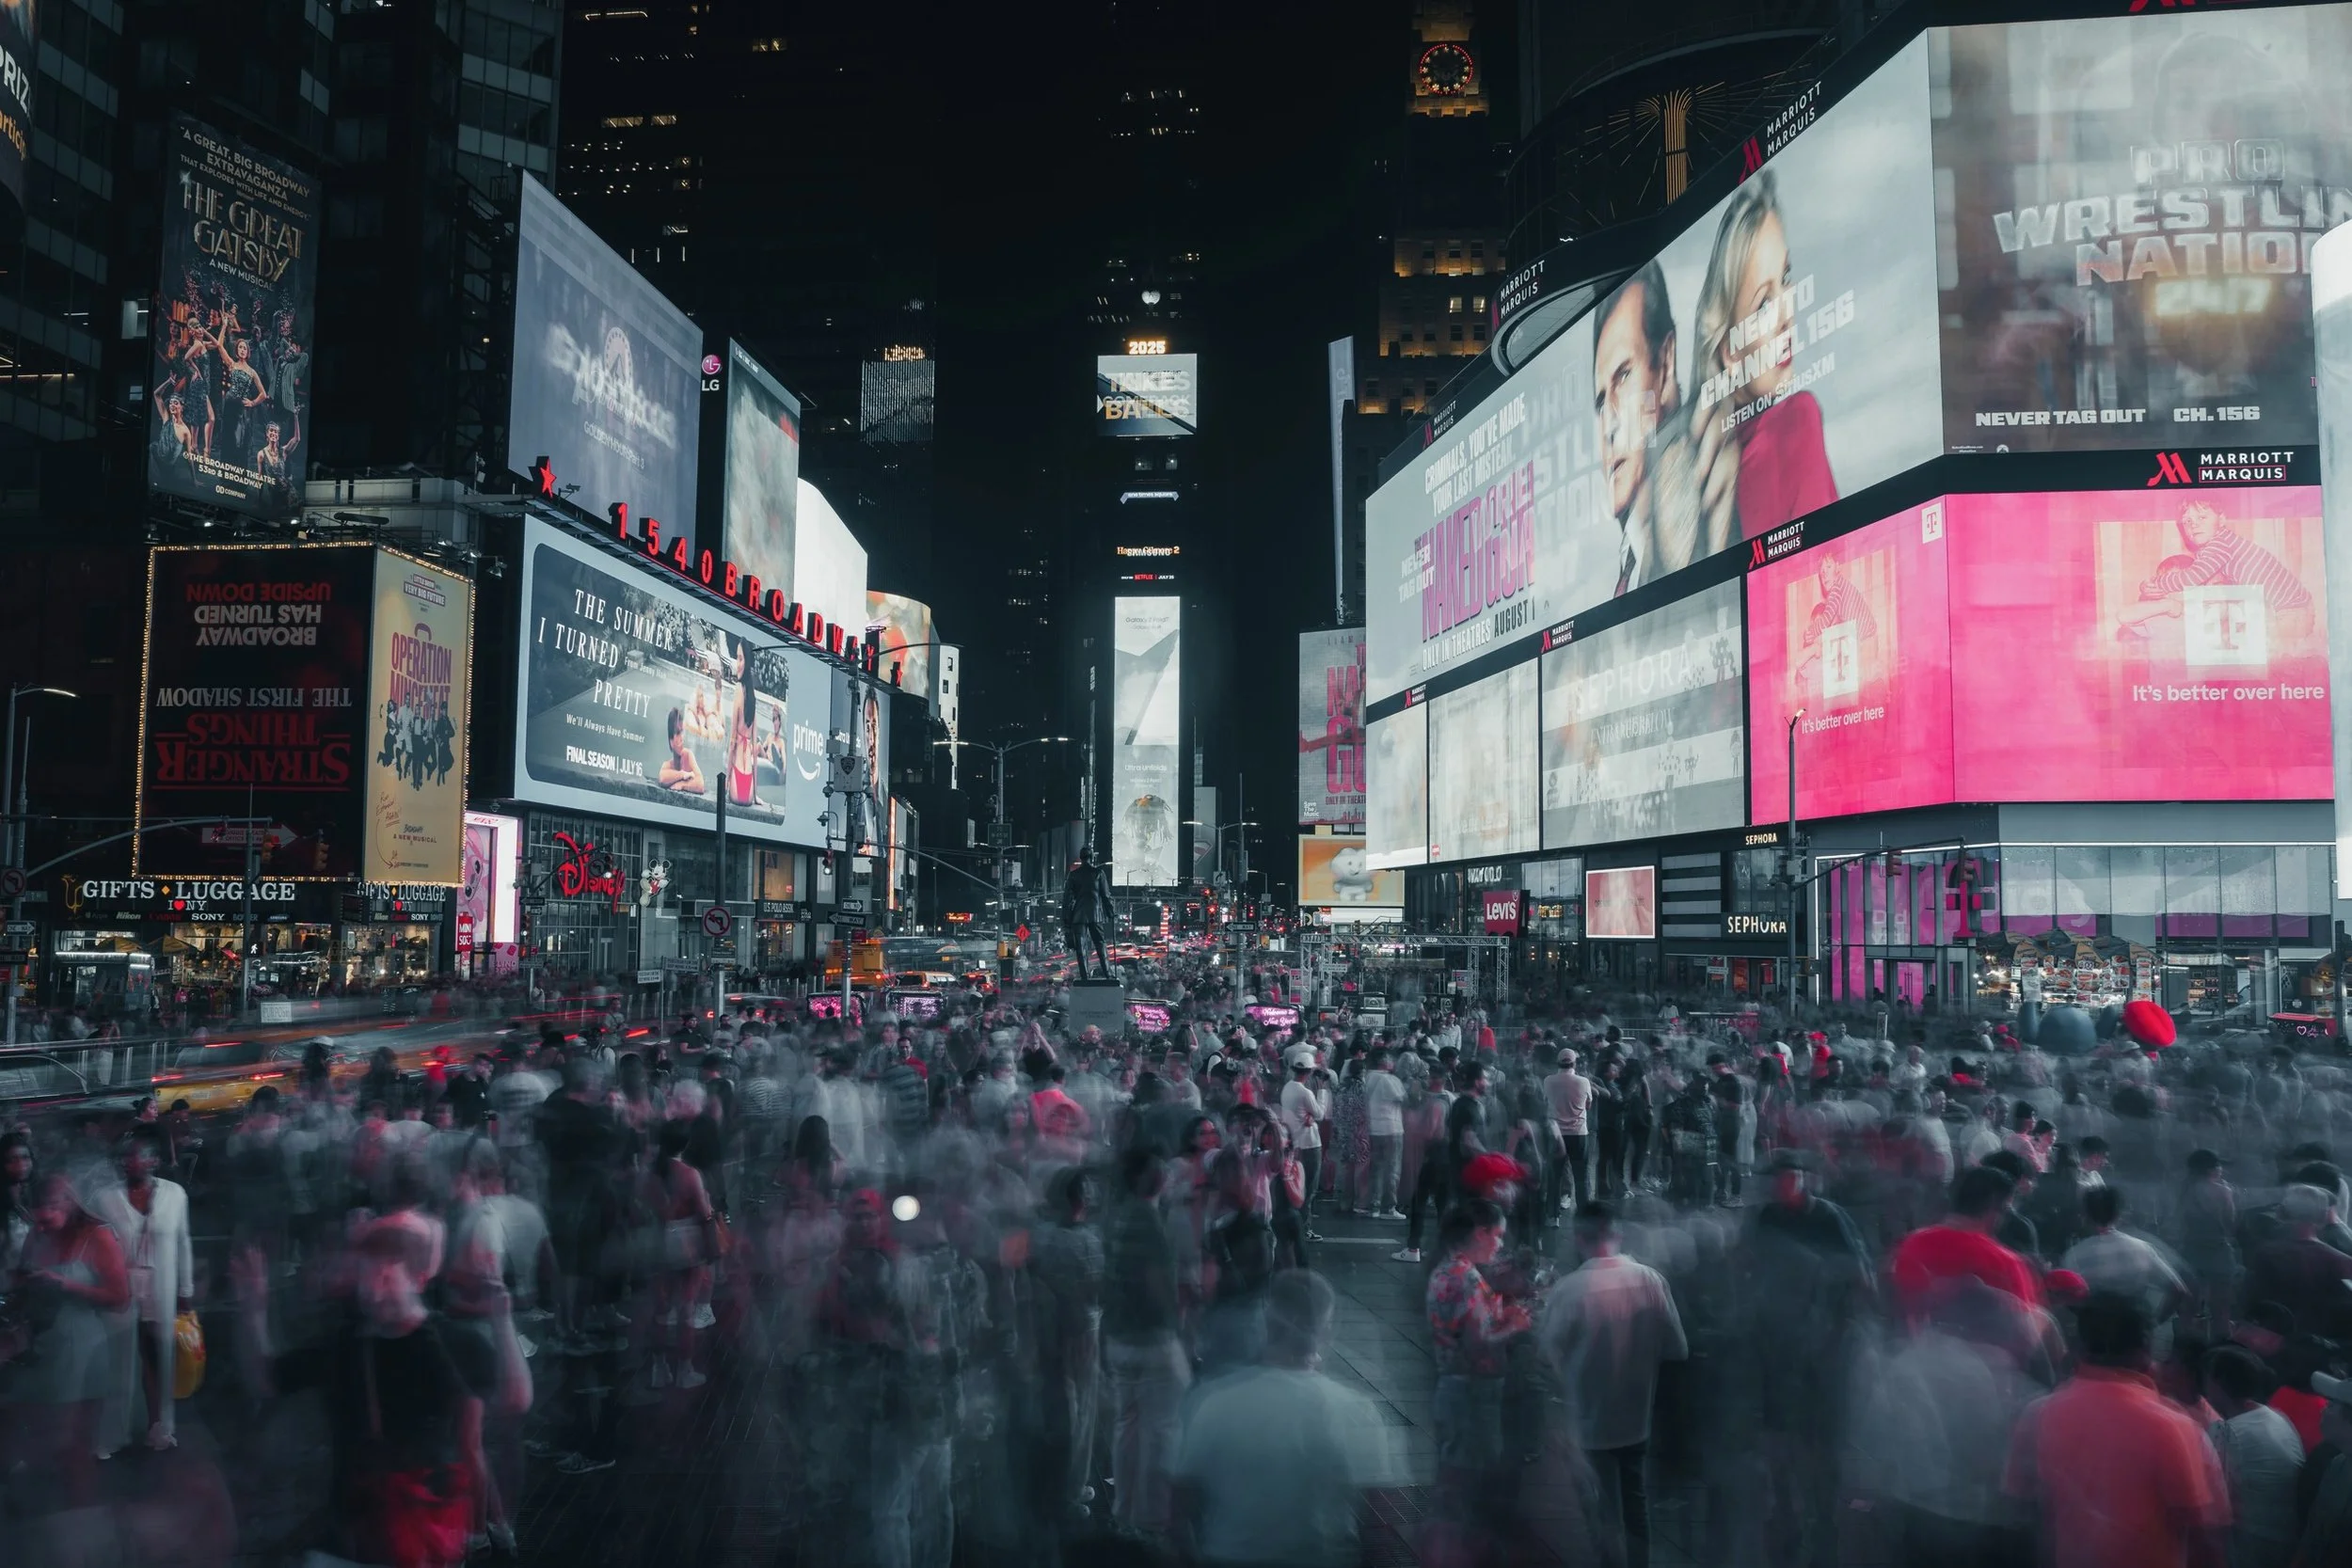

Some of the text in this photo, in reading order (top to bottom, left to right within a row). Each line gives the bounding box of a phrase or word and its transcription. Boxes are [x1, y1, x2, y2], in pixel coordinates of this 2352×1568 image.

[1767, 81, 1821, 137] MARRIOTT
[1767, 106, 1816, 157] MARQUIS
[194, 133, 231, 160] GREAT,
[234, 152, 252, 169] BIG
[255, 163, 310, 198] BROADWAY
[206, 152, 288, 201] EXTRAVAGANZA
[2130, 138, 2284, 185] PRO
[181, 154, 198, 168] THAT
[199, 163, 234, 185] EXPLODES
[236, 180, 253, 194] WITH
[254, 189, 267, 200] LIFE
[268, 197, 282, 208] AND
[183, 181, 306, 259] THE GREAT
[194, 220, 290, 281] GATSBY
[209, 258, 274, 292] A NEW MUSICAL
[1500, 260, 1545, 301] MARRIOTT
[1501, 281, 1538, 319] MARQUIS
[1729, 274, 1814, 356] NEW TO
[1128, 341, 1167, 355] 2025
[1700, 289, 1855, 411] CHANNEL 156
[701, 379, 720, 392] LG
[1433, 400, 1457, 425] MARRIOTT
[1434, 415, 1454, 436] MARQUIS
[1722, 400, 1755, 433] LISTEN
[1756, 392, 1772, 413] ON
[1976, 405, 2261, 427] NEVER TAG OUT CH. 156
[1424, 440, 1468, 495] CRIMINALS,
[1469, 413, 1498, 458] YOU'VE
[1499, 392, 1525, 436] MADE
[2200, 451, 2295, 465] MARRIOTT
[189, 452, 276, 485] THE BROADWAY THEATRE
[225, 471, 263, 489] BROADWAY
[2201, 467, 2284, 481] MARQUIS
[225, 488, 246, 499] COMPANY
[1433, 464, 1473, 517] YOUR LAST
[1767, 521, 1805, 545] MARRIOTT
[1768, 537, 1801, 558] MARQUIS
[1173, 546, 1180, 554] 2
[1422, 496, 1483, 643] NAKED
[185, 582, 332, 602] UPSIDE DOWN
[613, 502, 876, 672] 1540 BROADWAY
[194, 604, 322, 625] HAS TURNED
[574, 589, 673, 652] THE SUMMER
[1494, 595, 1535, 638] AUGUST 1
[1552, 620, 1575, 635] MARRIOTT
[196, 626, 317, 647] BROADWAY
[538, 616, 618, 668] I TURNED
[1422, 618, 1491, 672] ONLY IN THEATRES
[1552, 631, 1572, 645] MARQUIS
[391, 631, 452, 684] OPERATION
[155, 687, 353, 707] THE FIRST SHADOW
[593, 678, 651, 719] PRETTY
[2133, 683, 2324, 702] It's better over here
[186, 712, 320, 746] THINGS
[584, 719, 605, 734] Always
[607, 725, 621, 737] Have
[623, 729, 645, 743] Summer
[1802, 705, 1884, 734] It's better over here
[792, 720, 824, 756] prime
[154, 742, 351, 784] STRANGER
[566, 745, 643, 776] FINAL SEASON JULY 16
[1745, 832, 1778, 845] SEPHORA
[552, 831, 626, 915] Disney
[83, 880, 295, 901] GIFTS LUGGAGE
[185, 900, 207, 911] NY
[358, 882, 446, 901] GIFTS LUGGAGE
[116, 911, 142, 920] Nikon
[771, 903, 782, 912] POLO
[1727, 916, 1788, 933] SEPHORA
[1280, 1018, 1296, 1027] York
